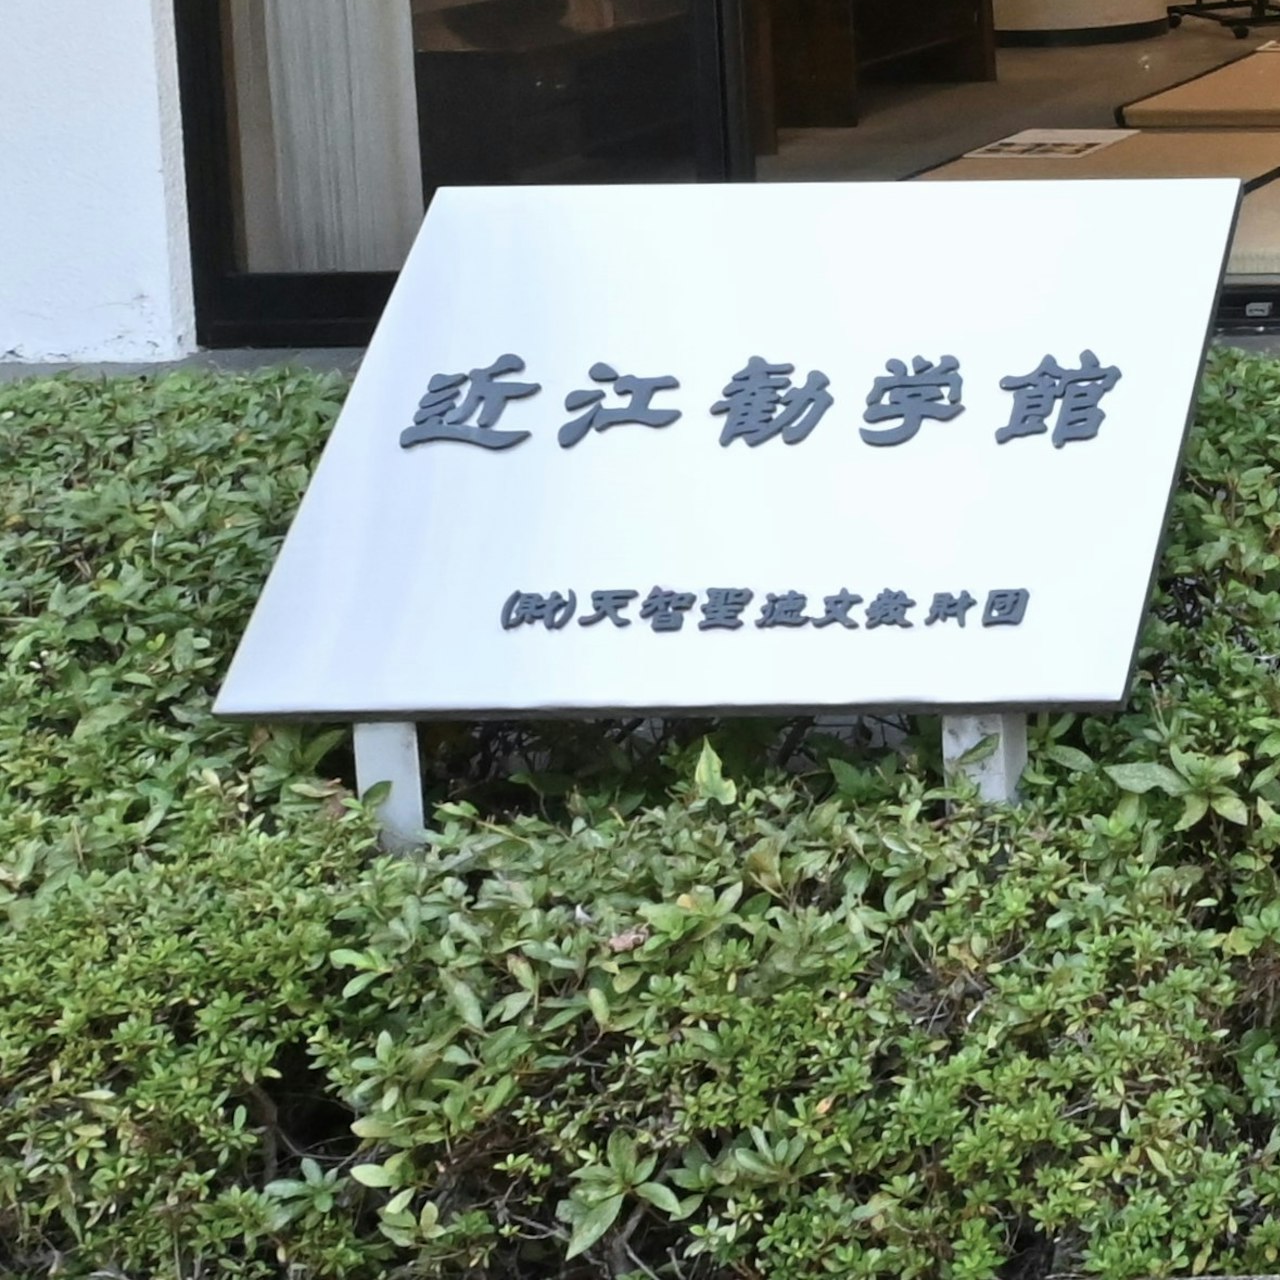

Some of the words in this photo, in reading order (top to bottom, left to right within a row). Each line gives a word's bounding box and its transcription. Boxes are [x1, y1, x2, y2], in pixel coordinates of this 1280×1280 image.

[398, 347, 1123, 450] 近江勧学館
